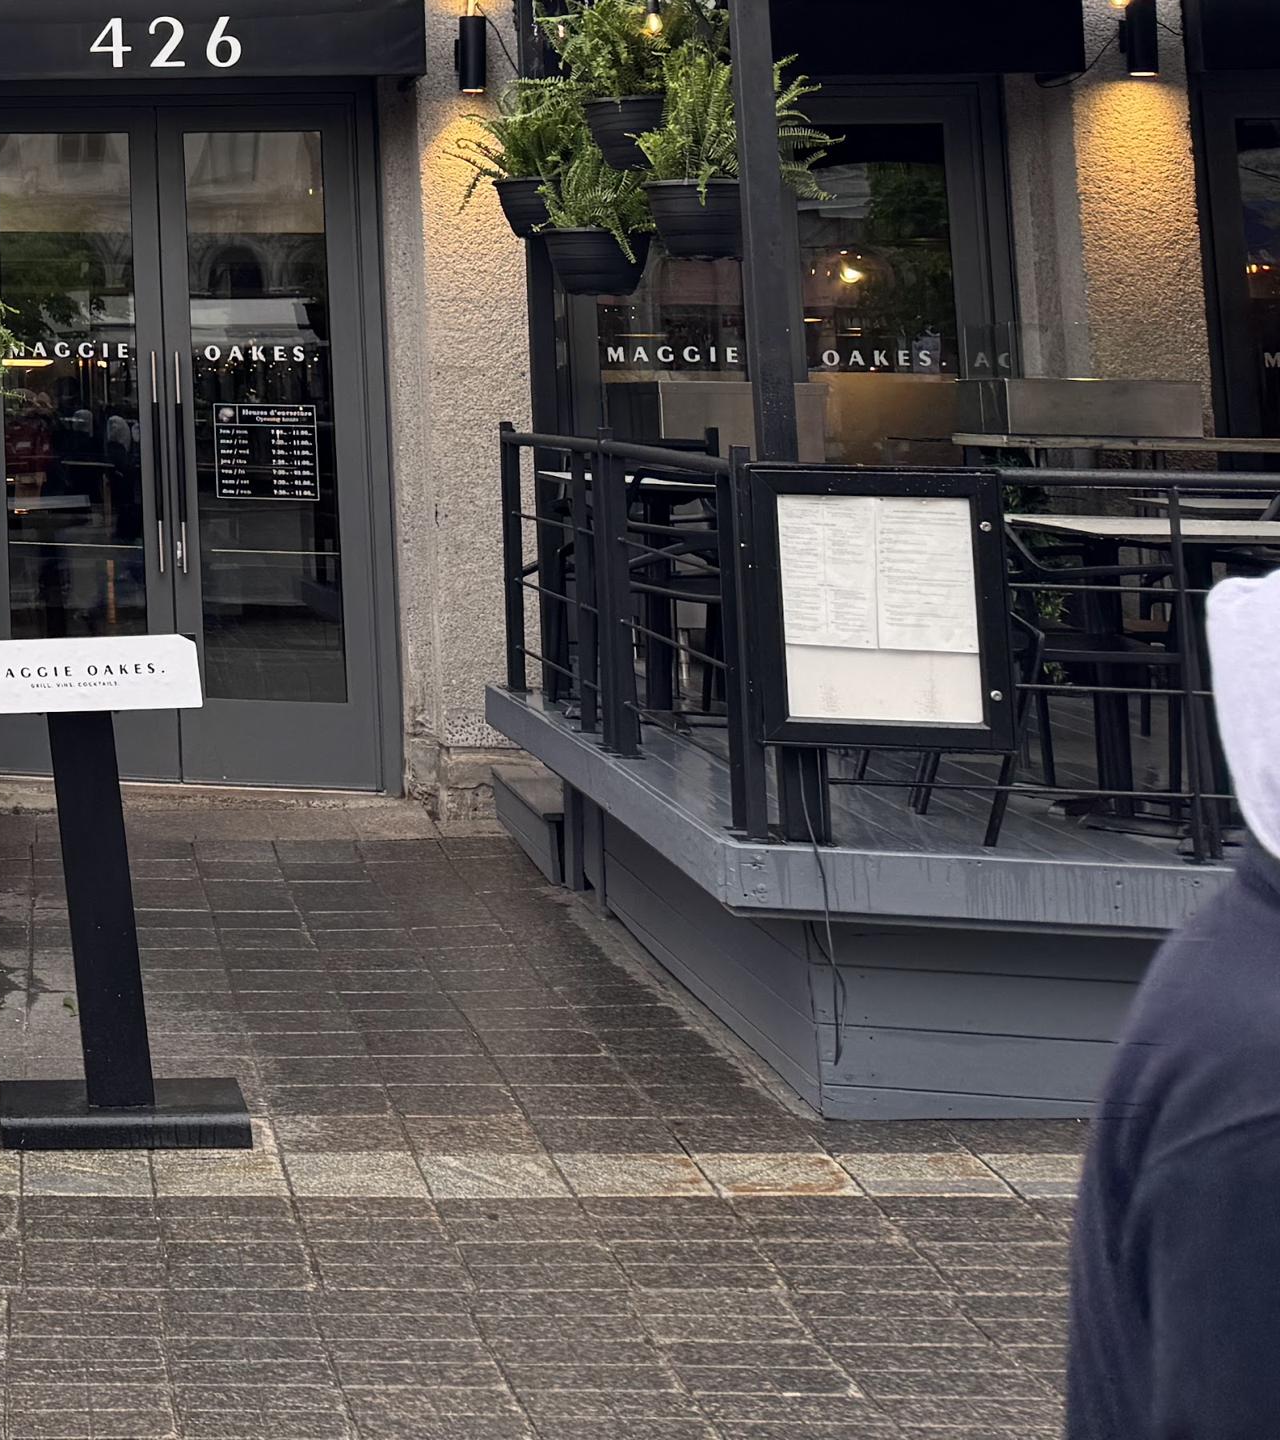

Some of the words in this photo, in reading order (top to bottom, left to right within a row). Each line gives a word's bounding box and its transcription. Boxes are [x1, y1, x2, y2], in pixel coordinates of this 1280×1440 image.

[89, 15, 243, 69] 426
[204, 344, 319, 362] OAKES.
[607, 345, 739, 363] MAGGIE
[822, 349, 947, 367] OAKES.
[87, 662, 166, 676] OAKES.
